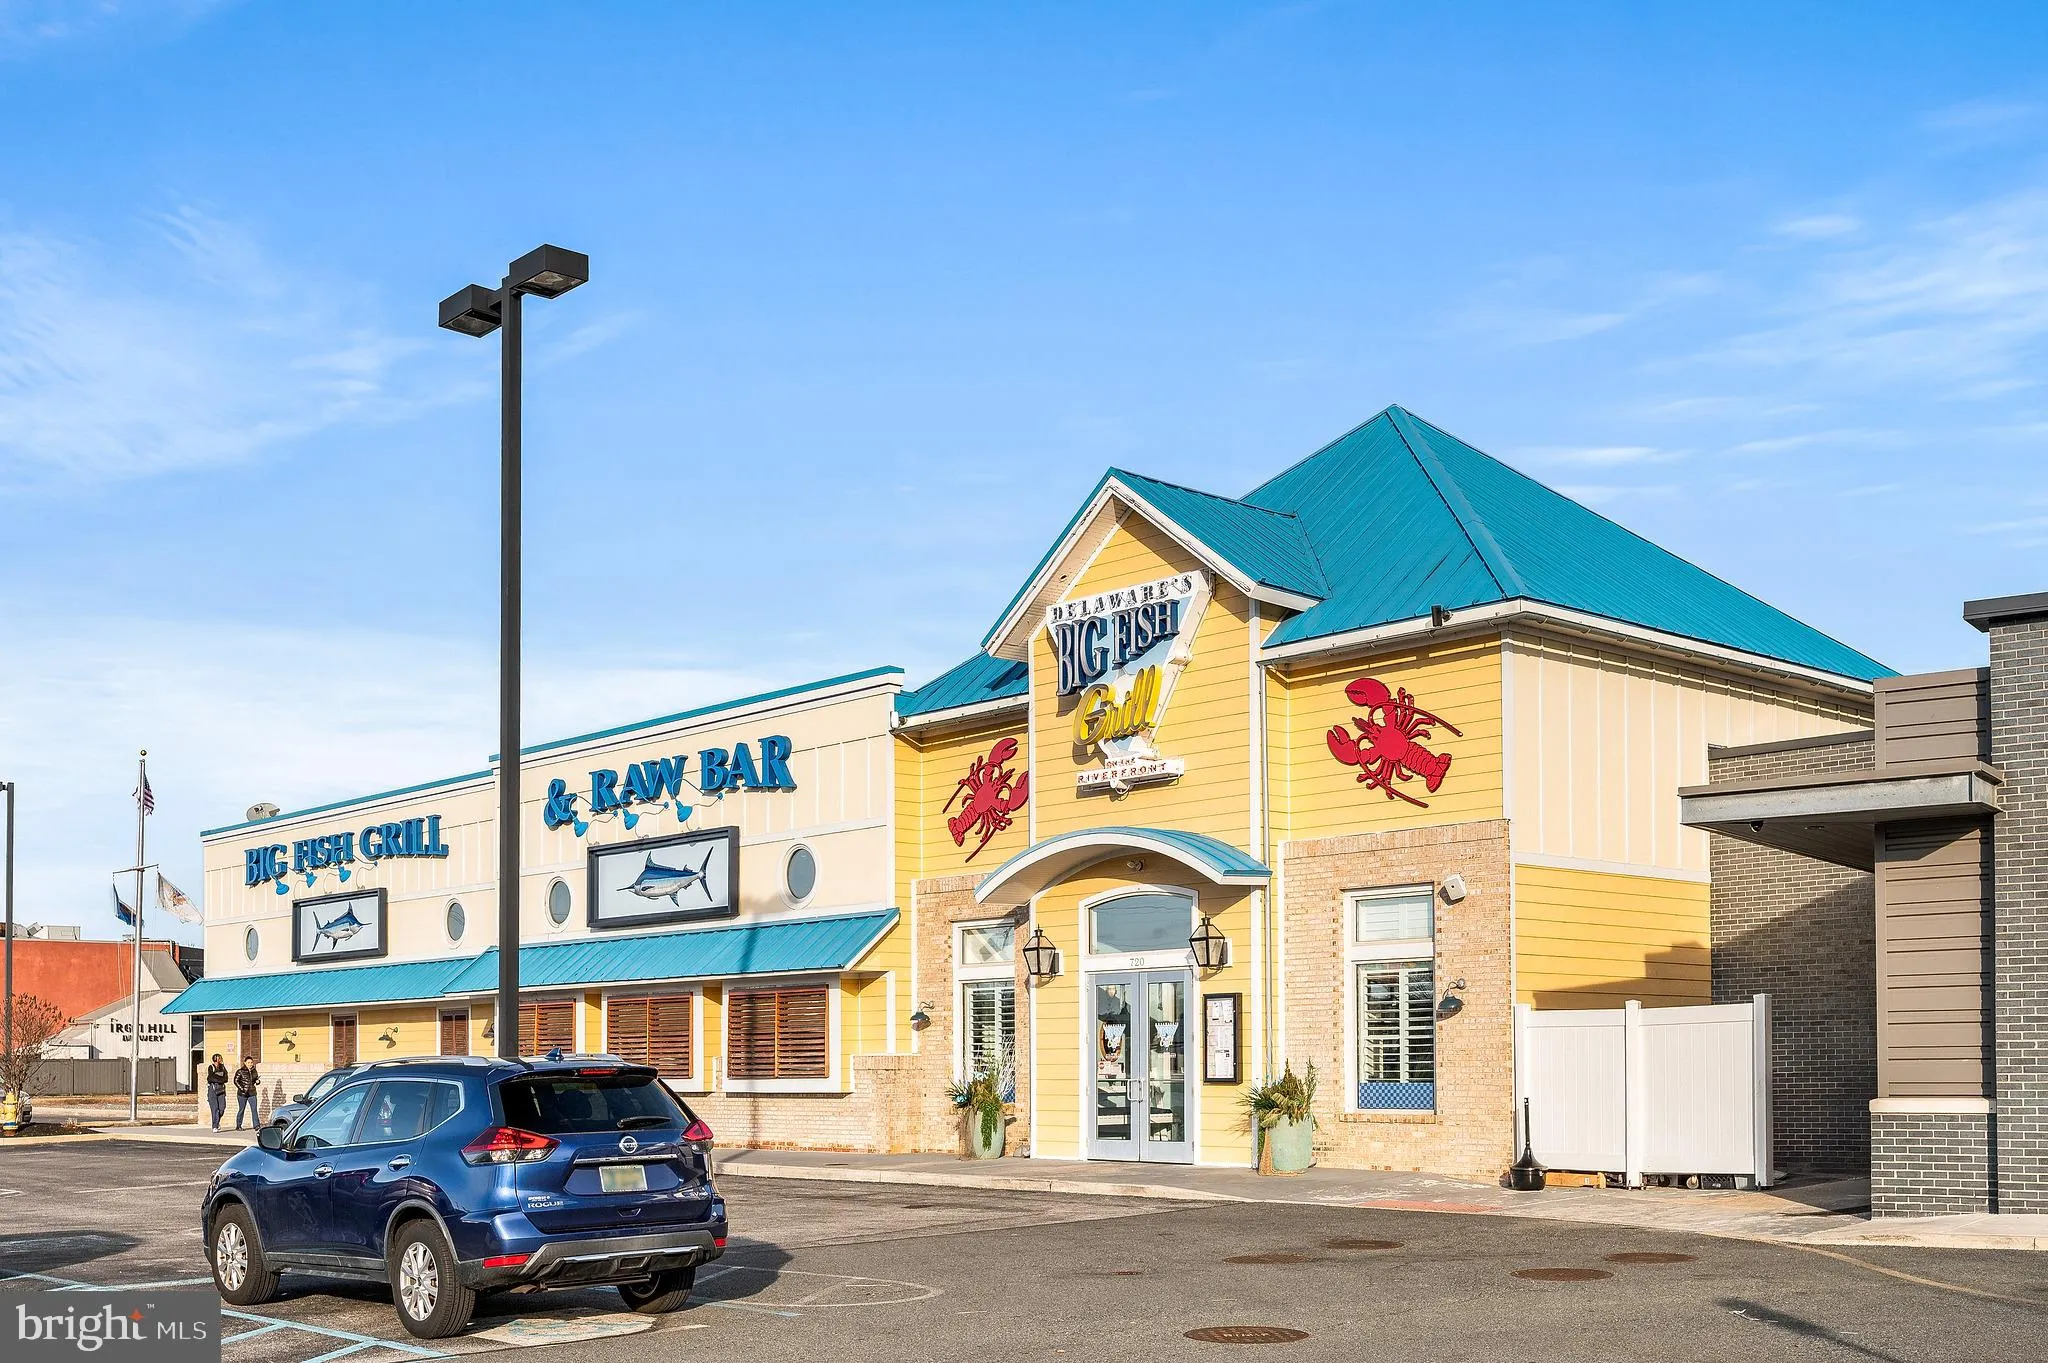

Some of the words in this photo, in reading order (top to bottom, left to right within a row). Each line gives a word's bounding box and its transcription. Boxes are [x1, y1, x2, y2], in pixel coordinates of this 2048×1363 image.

[1050, 575, 1193, 623] DELAWARE'S
[1056, 615, 1109, 696] BIG
[1112, 598, 1180, 666] FISH
[1073, 664, 1162, 745] Grill
[544, 778, 578, 831] &
[589, 755, 688, 815] RAW
[698, 734, 797, 793] BAR
[1077, 763, 1167, 783] RIVERFRONT
[244, 844, 288, 887] BIG
[292, 832, 355, 874] FISH
[359, 814, 449, 860] GRILL
[1129, 957, 1145, 967] 720
[122, 1034, 164, 1042] BRWERY
[148, 1023, 177, 1034] HILL
[528, 1200, 564, 1209] ROGUE
